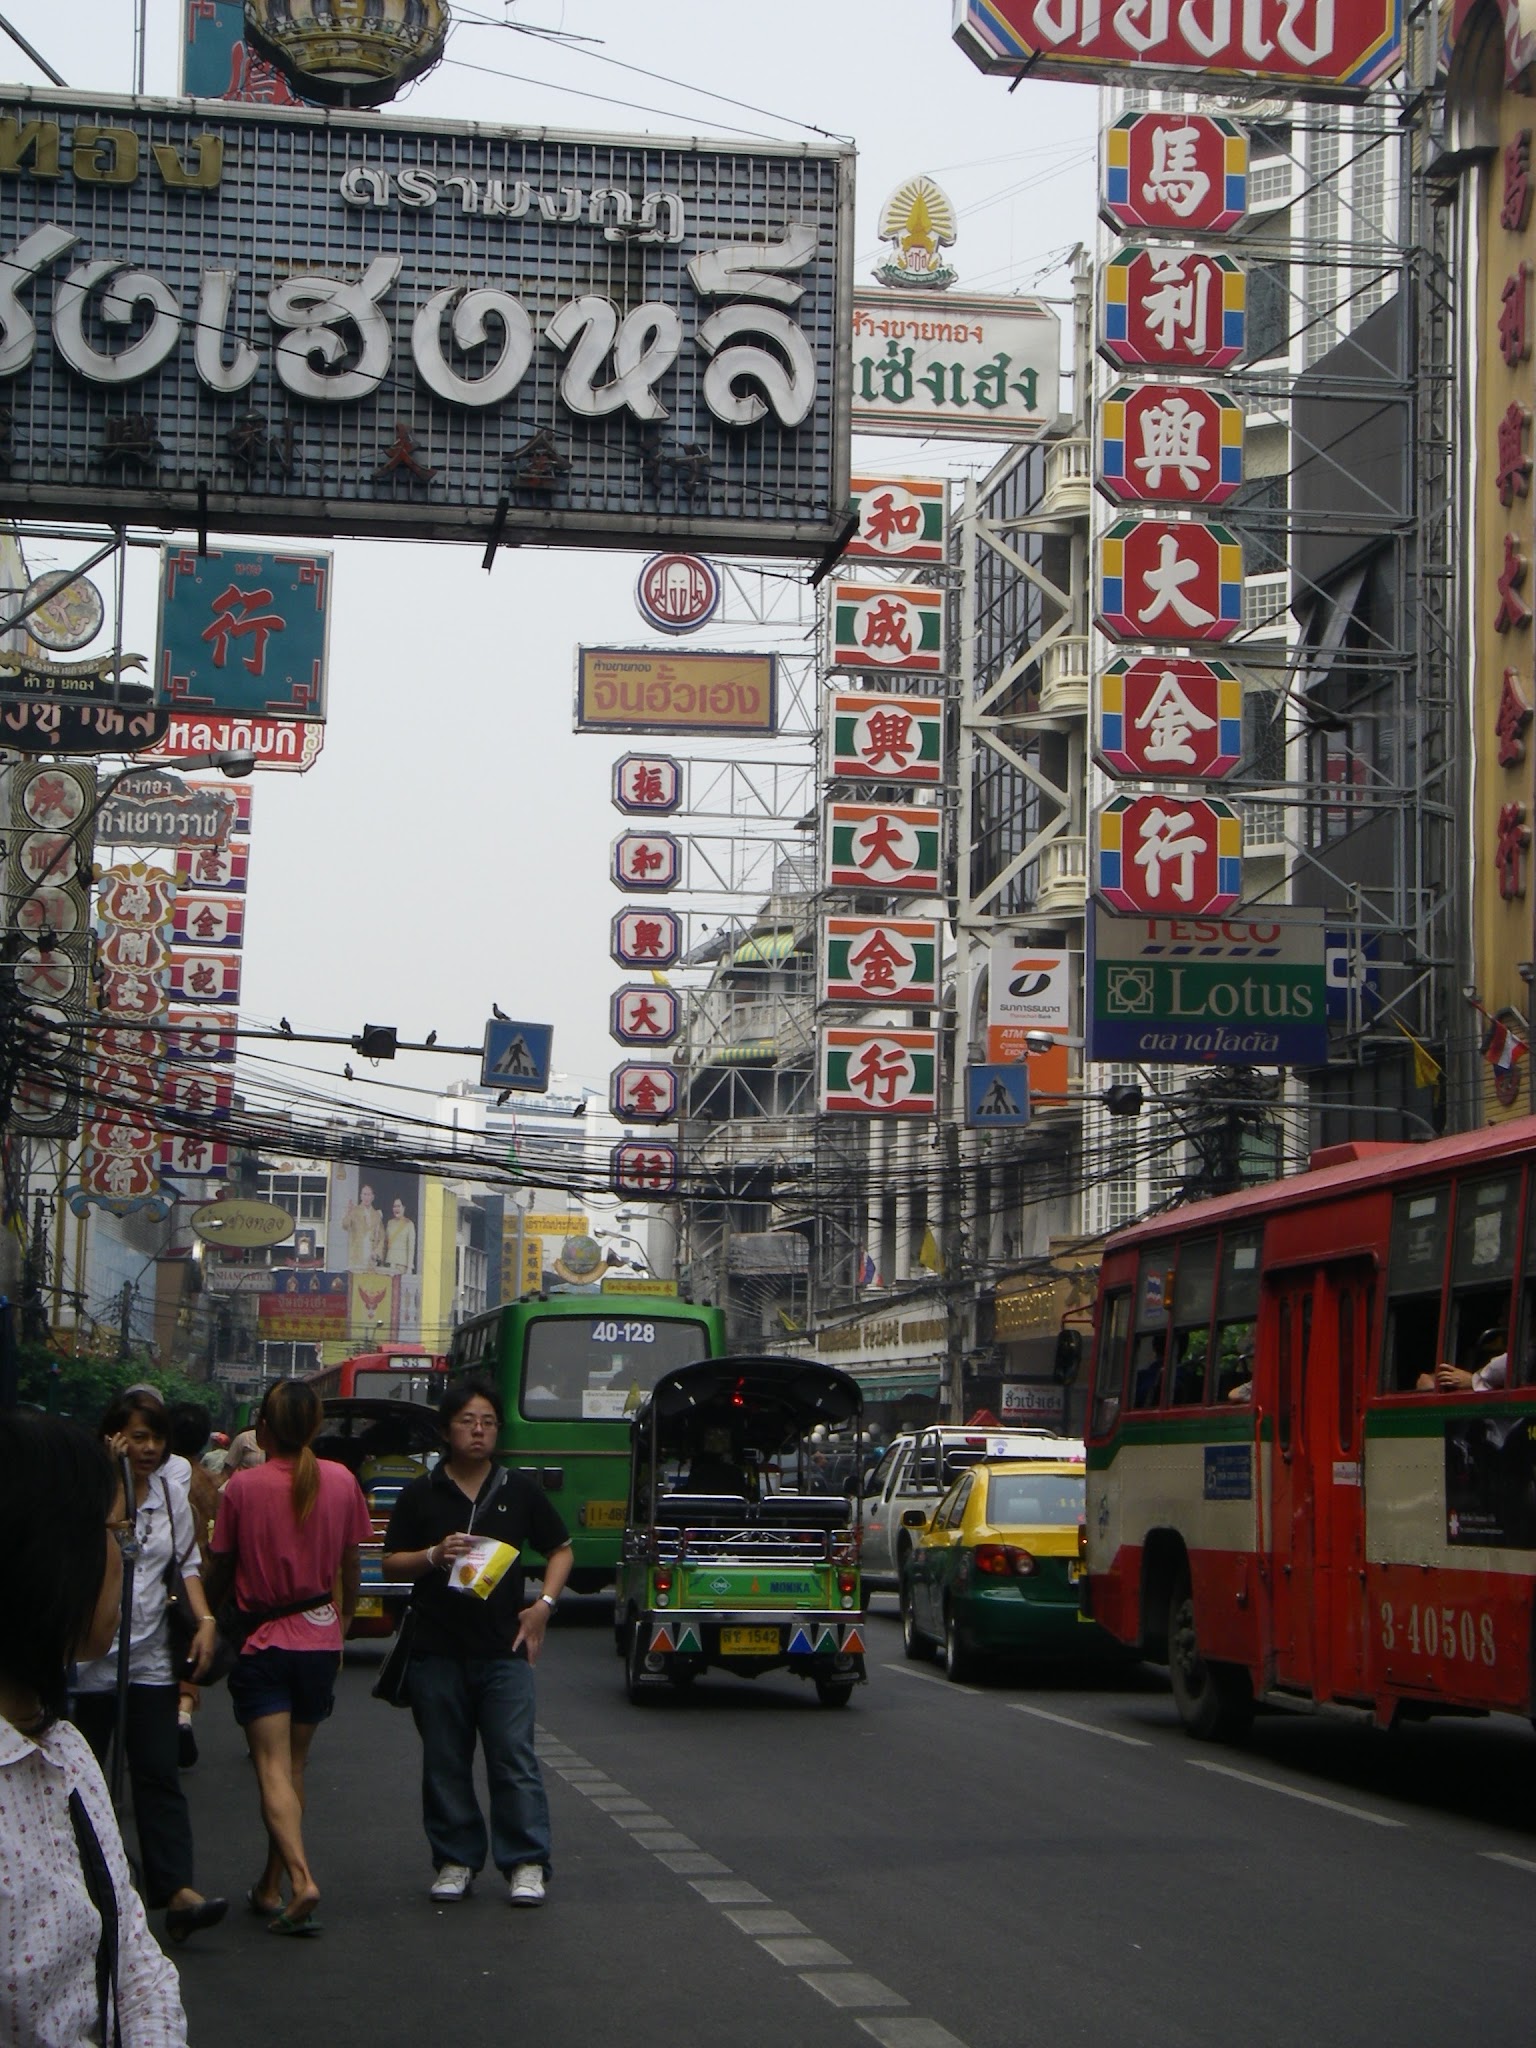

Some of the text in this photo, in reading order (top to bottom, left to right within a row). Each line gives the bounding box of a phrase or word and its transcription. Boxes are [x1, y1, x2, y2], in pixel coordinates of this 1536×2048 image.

[851, 340, 1039, 412] เซ่งเฮง
[1133, 126, 1218, 902] 馬 利 興 大 金 行
[202, 583, 286, 676] 行
[850, 494, 922, 1102] 和 成 興 大 金 行
[630, 844, 664, 877] 和
[192, 905, 223, 937] 金
[1167, 968, 1314, 1018] Lotus
[629, 998, 663, 1034] 大
[629, 1075, 666, 1111] 金
[103, 1157, 139, 1193] 行
[591, 1321, 656, 1343] 40-128
[769, 1582, 810, 1593] MONIKA
